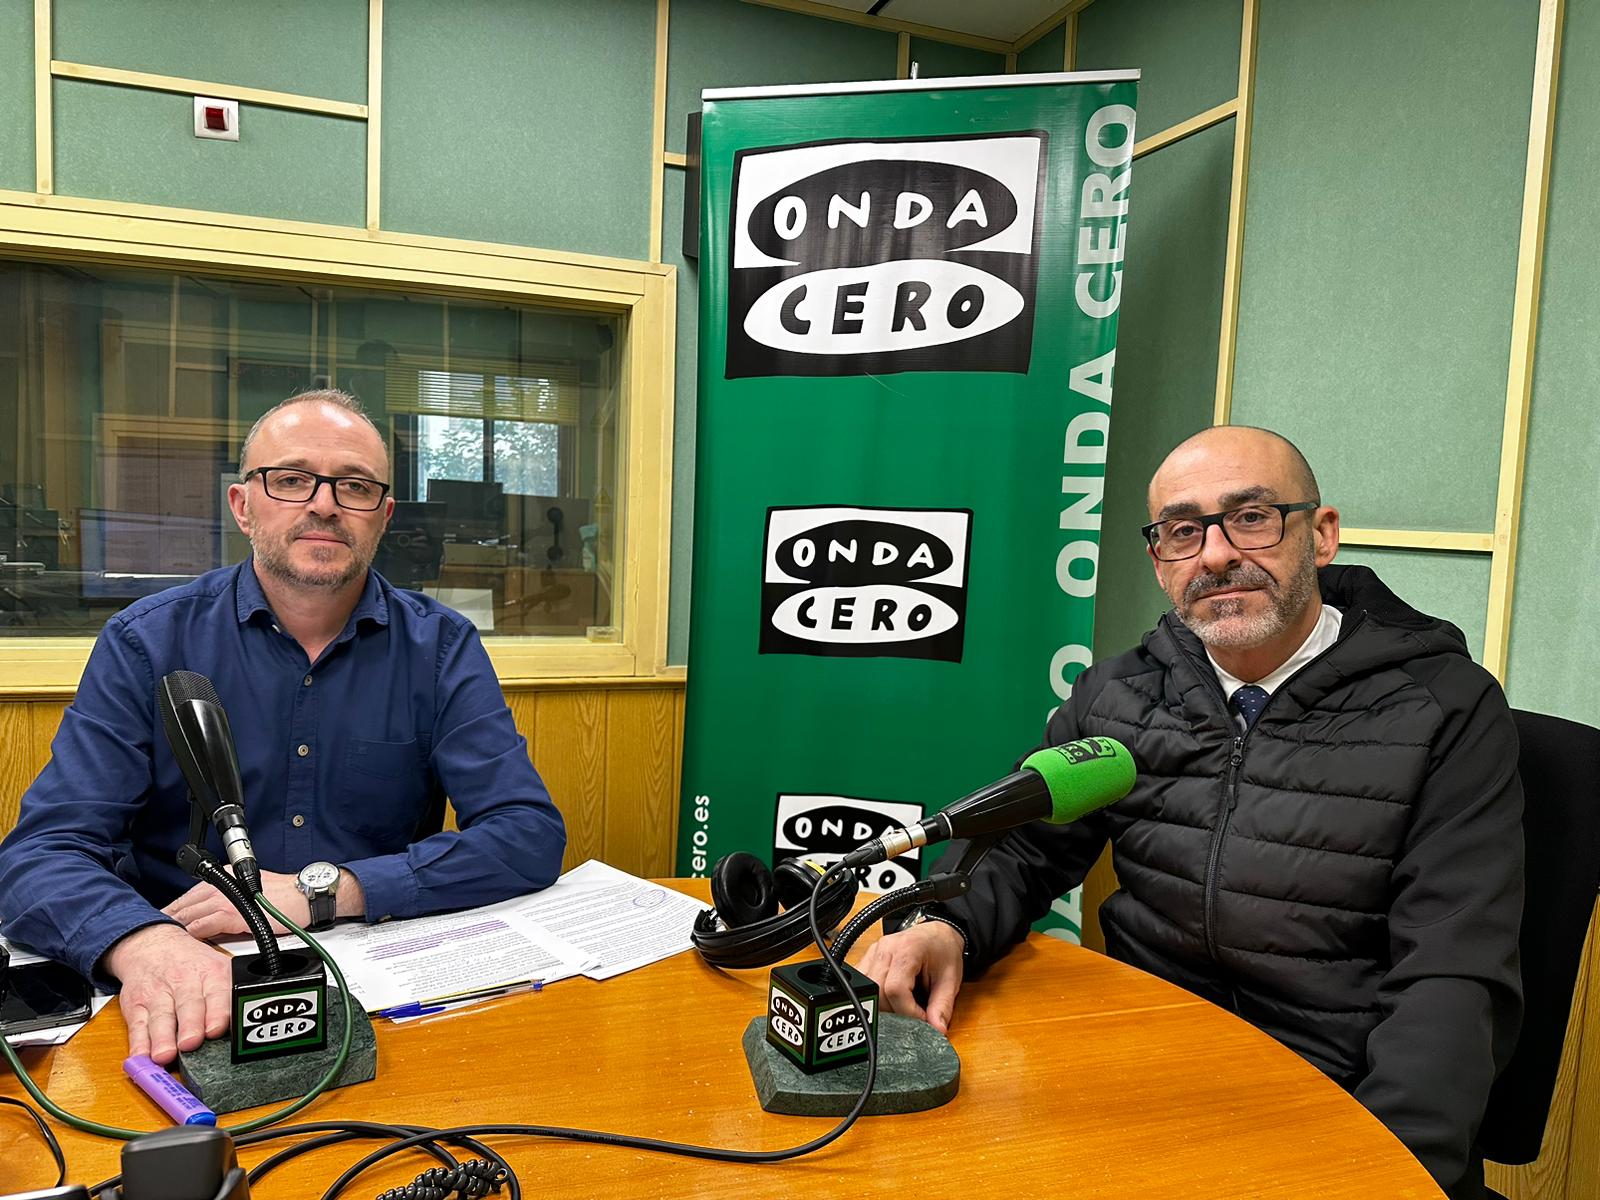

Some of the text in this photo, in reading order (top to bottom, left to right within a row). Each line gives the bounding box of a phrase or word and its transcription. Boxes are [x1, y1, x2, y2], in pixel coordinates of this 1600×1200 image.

[773, 189, 988, 240] ONDA
[1075, 104, 1136, 319] CERO
[779, 281, 985, 335] CERO
[1056, 349, 1116, 598] ONDA
[792, 538, 935, 569] ONDA
[796, 596, 933, 632] CERO
[253, 1002, 307, 1020] ONDA
[775, 998, 800, 1024] ONDA
[825, 1013, 861, 1029] OND
[256, 1021, 308, 1039] CERO
[775, 1018, 799, 1043] CERO
[826, 1031, 867, 1049] CERO
